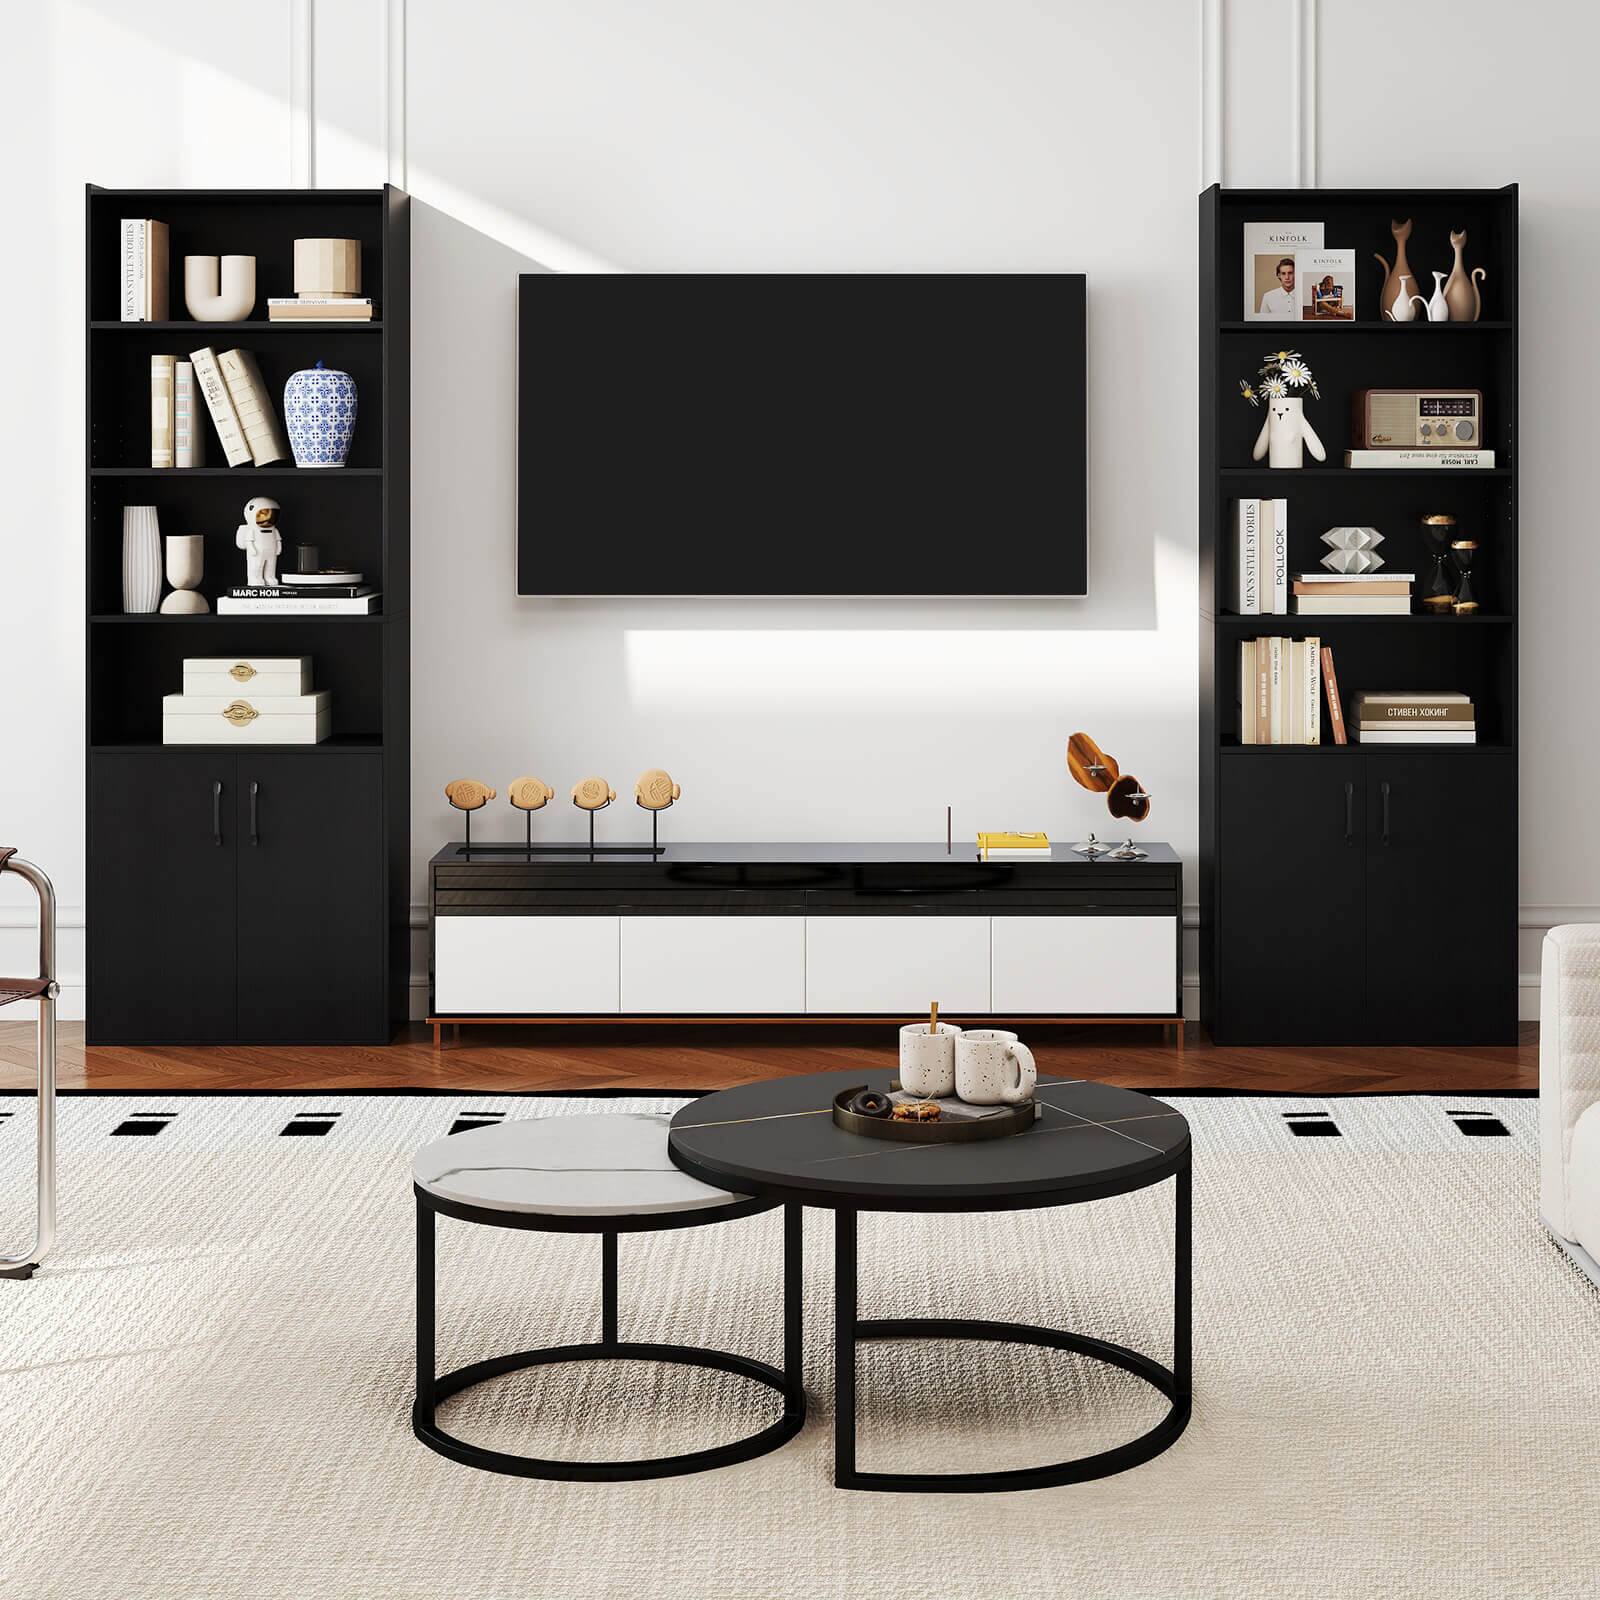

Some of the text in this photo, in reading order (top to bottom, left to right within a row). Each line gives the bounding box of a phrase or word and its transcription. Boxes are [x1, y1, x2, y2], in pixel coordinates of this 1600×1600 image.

[1246, 504, 1255, 545] STORIES
[1246, 547, 1255, 576] STYLE
[1276, 529, 1285, 586] POLLOCK
[232, 589, 259, 597] MARC
[259, 589, 280, 597] HOM
[1387, 708, 1448, 716] СТИВЕН ХОКИНГ
